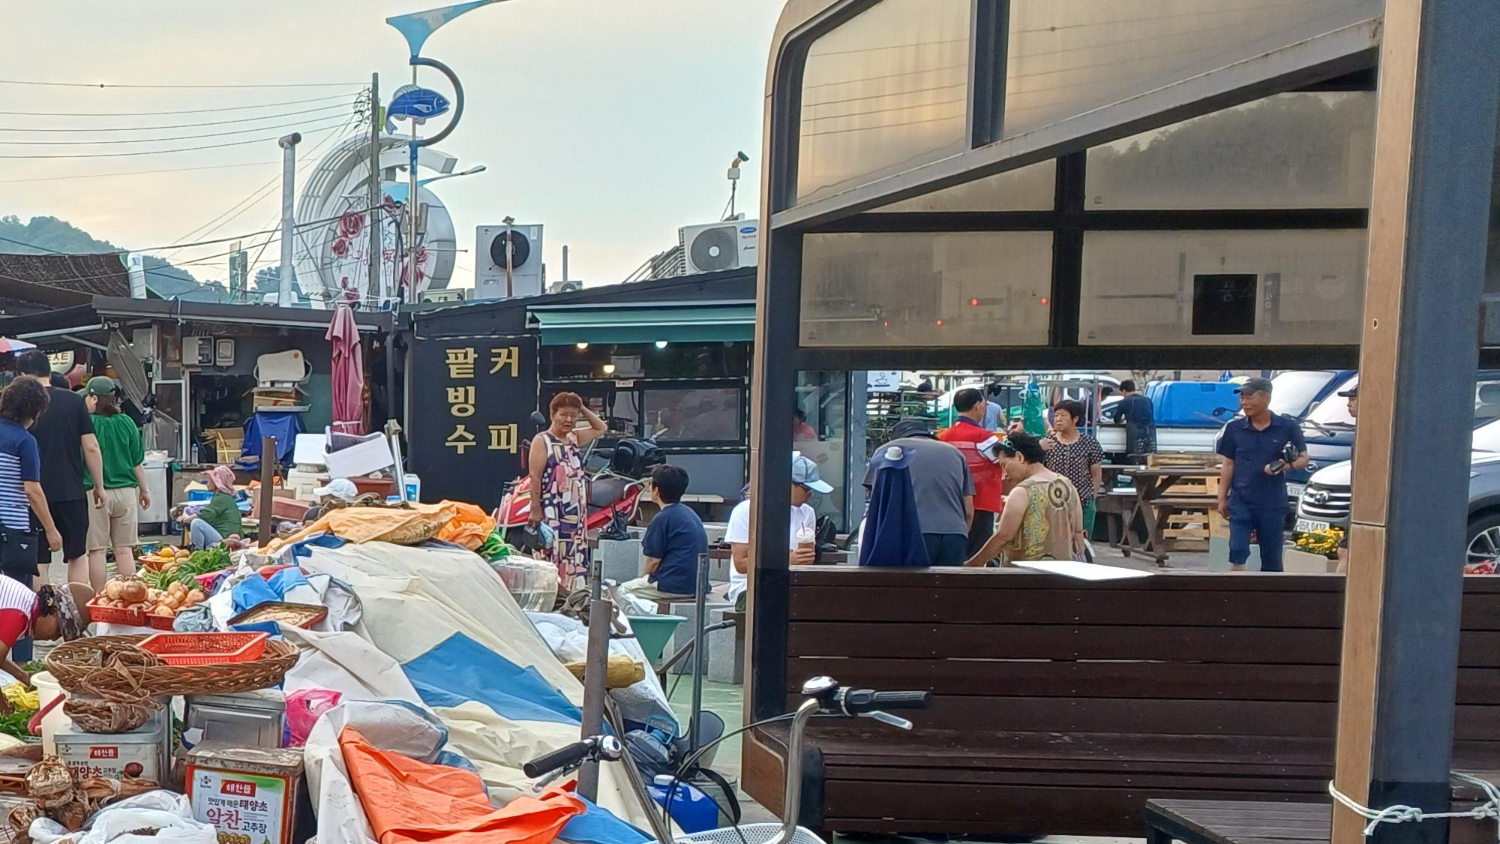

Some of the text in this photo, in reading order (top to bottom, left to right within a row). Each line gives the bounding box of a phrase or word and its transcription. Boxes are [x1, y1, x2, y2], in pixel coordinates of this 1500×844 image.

[444, 347, 478, 454] 팥빙수
[487, 346, 519, 454] 커피
[225, 783, 251, 795] 해찬들
[240, 800, 268, 812] 태양초
[206, 808, 242, 830] 알찬
[242, 821, 267, 834] 고추장
